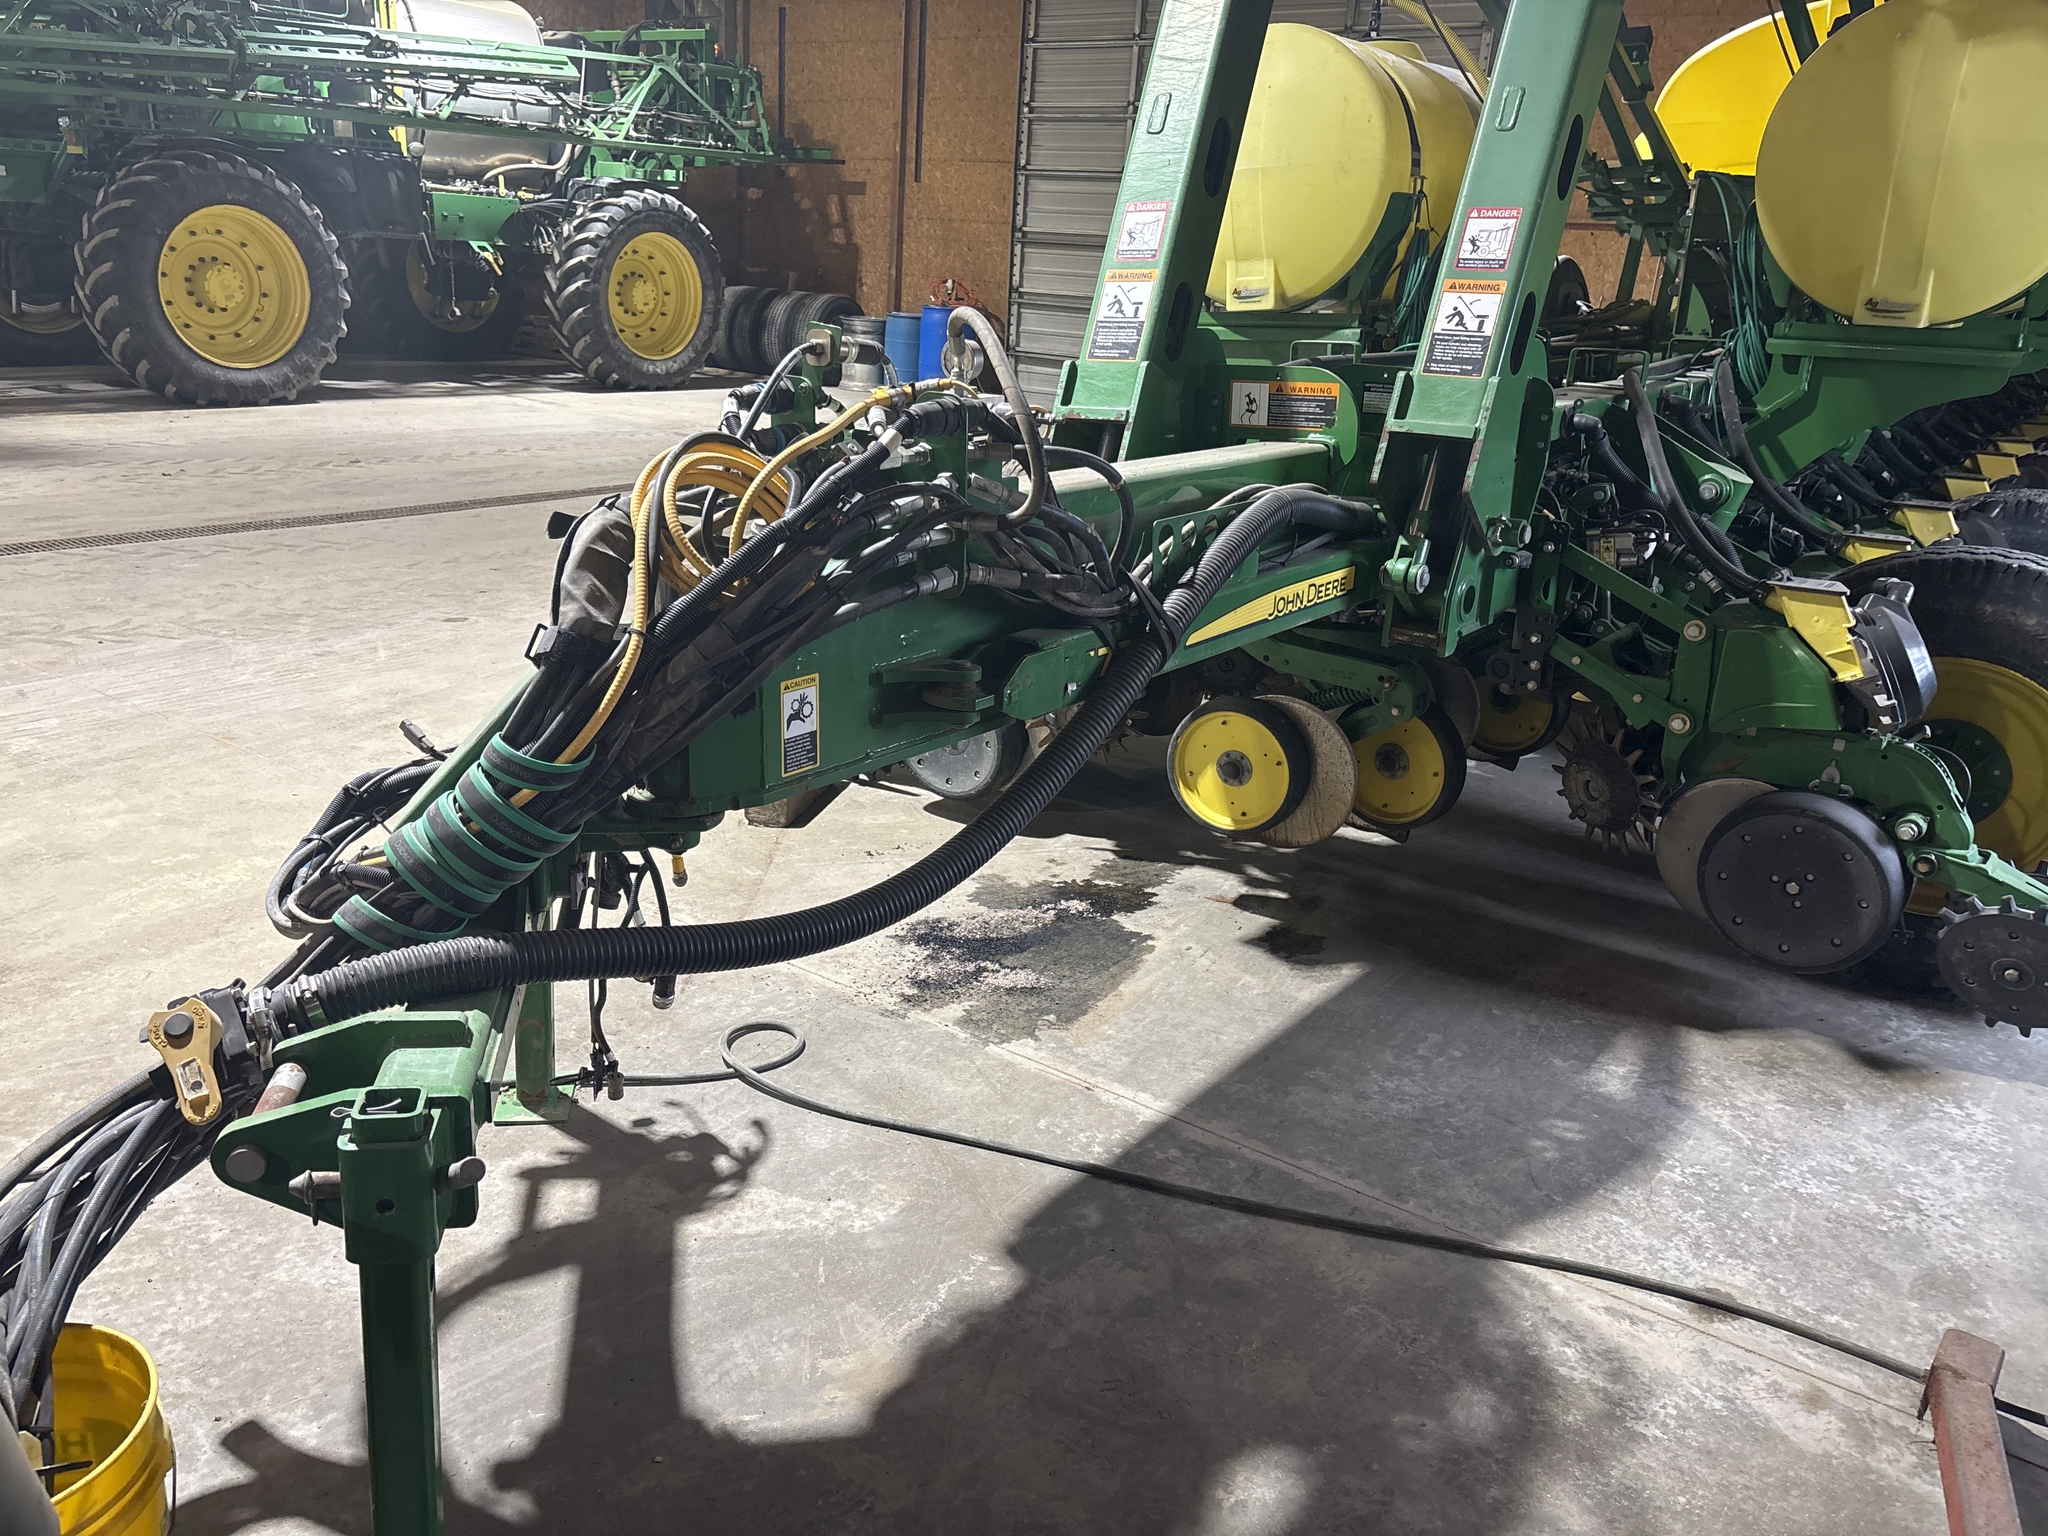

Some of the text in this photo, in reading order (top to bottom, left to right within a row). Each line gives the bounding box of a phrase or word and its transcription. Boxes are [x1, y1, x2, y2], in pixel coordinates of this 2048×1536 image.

[1479, 209, 1518, 217] DANGER
[1117, 271, 1153, 280] WARNING
[1458, 282, 1500, 292] WARNING
[1289, 386, 1332, 395] WARNING
[1268, 576, 1348, 618] JOHN DEERE
[790, 677, 816, 689] CAUTION
[487, 748, 531, 779] Outback Wrap
[490, 814, 543, 848] Outback Wrap
[394, 840, 432, 883] Outback Wrap
[191, 1006, 206, 1030] OPEN
[152, 1020, 168, 1048] CLOSE
